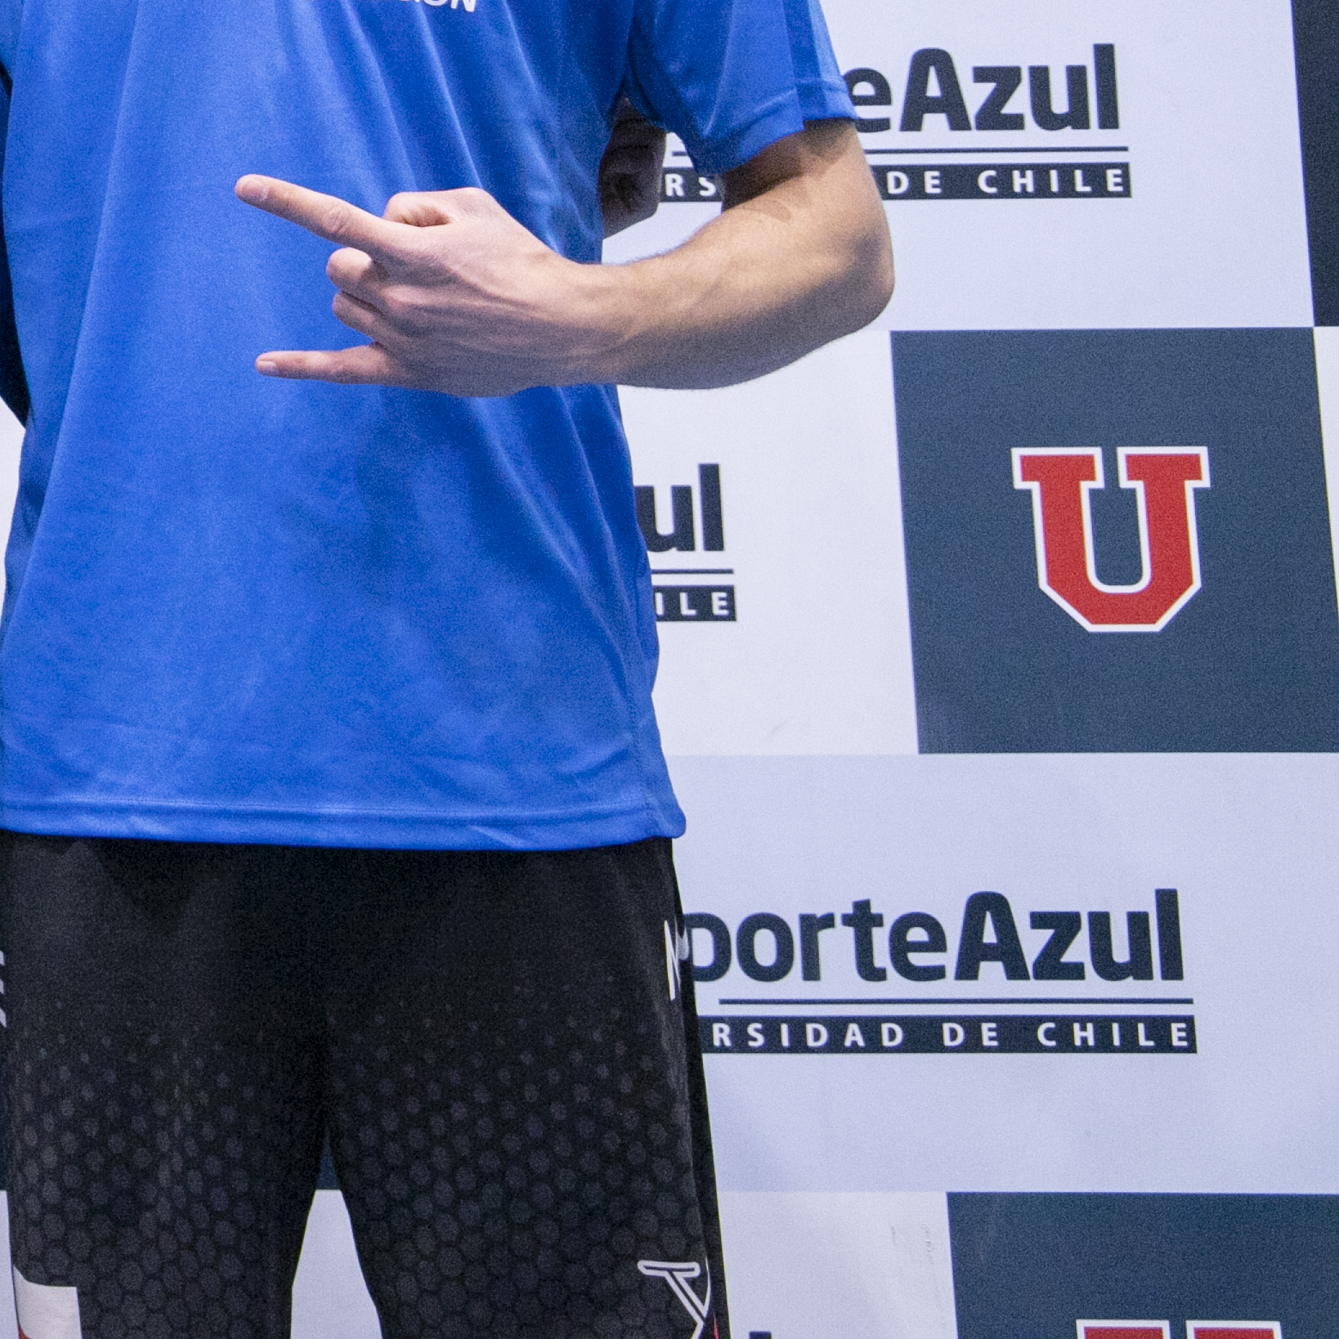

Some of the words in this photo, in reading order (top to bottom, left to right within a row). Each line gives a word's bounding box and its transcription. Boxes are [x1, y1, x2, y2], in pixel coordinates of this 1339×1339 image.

[888, 171, 941, 194] DE
[979, 169, 1123, 194] CHILE
[1010, 446, 1211, 633] U
[654, 592, 730, 617] ILE
[684, 888, 1184, 982] porteAzul
[712, 1022, 904, 1047] RSIDAD
[943, 1022, 999, 1046] DE
[1037, 1022, 1189, 1047] CHILE
